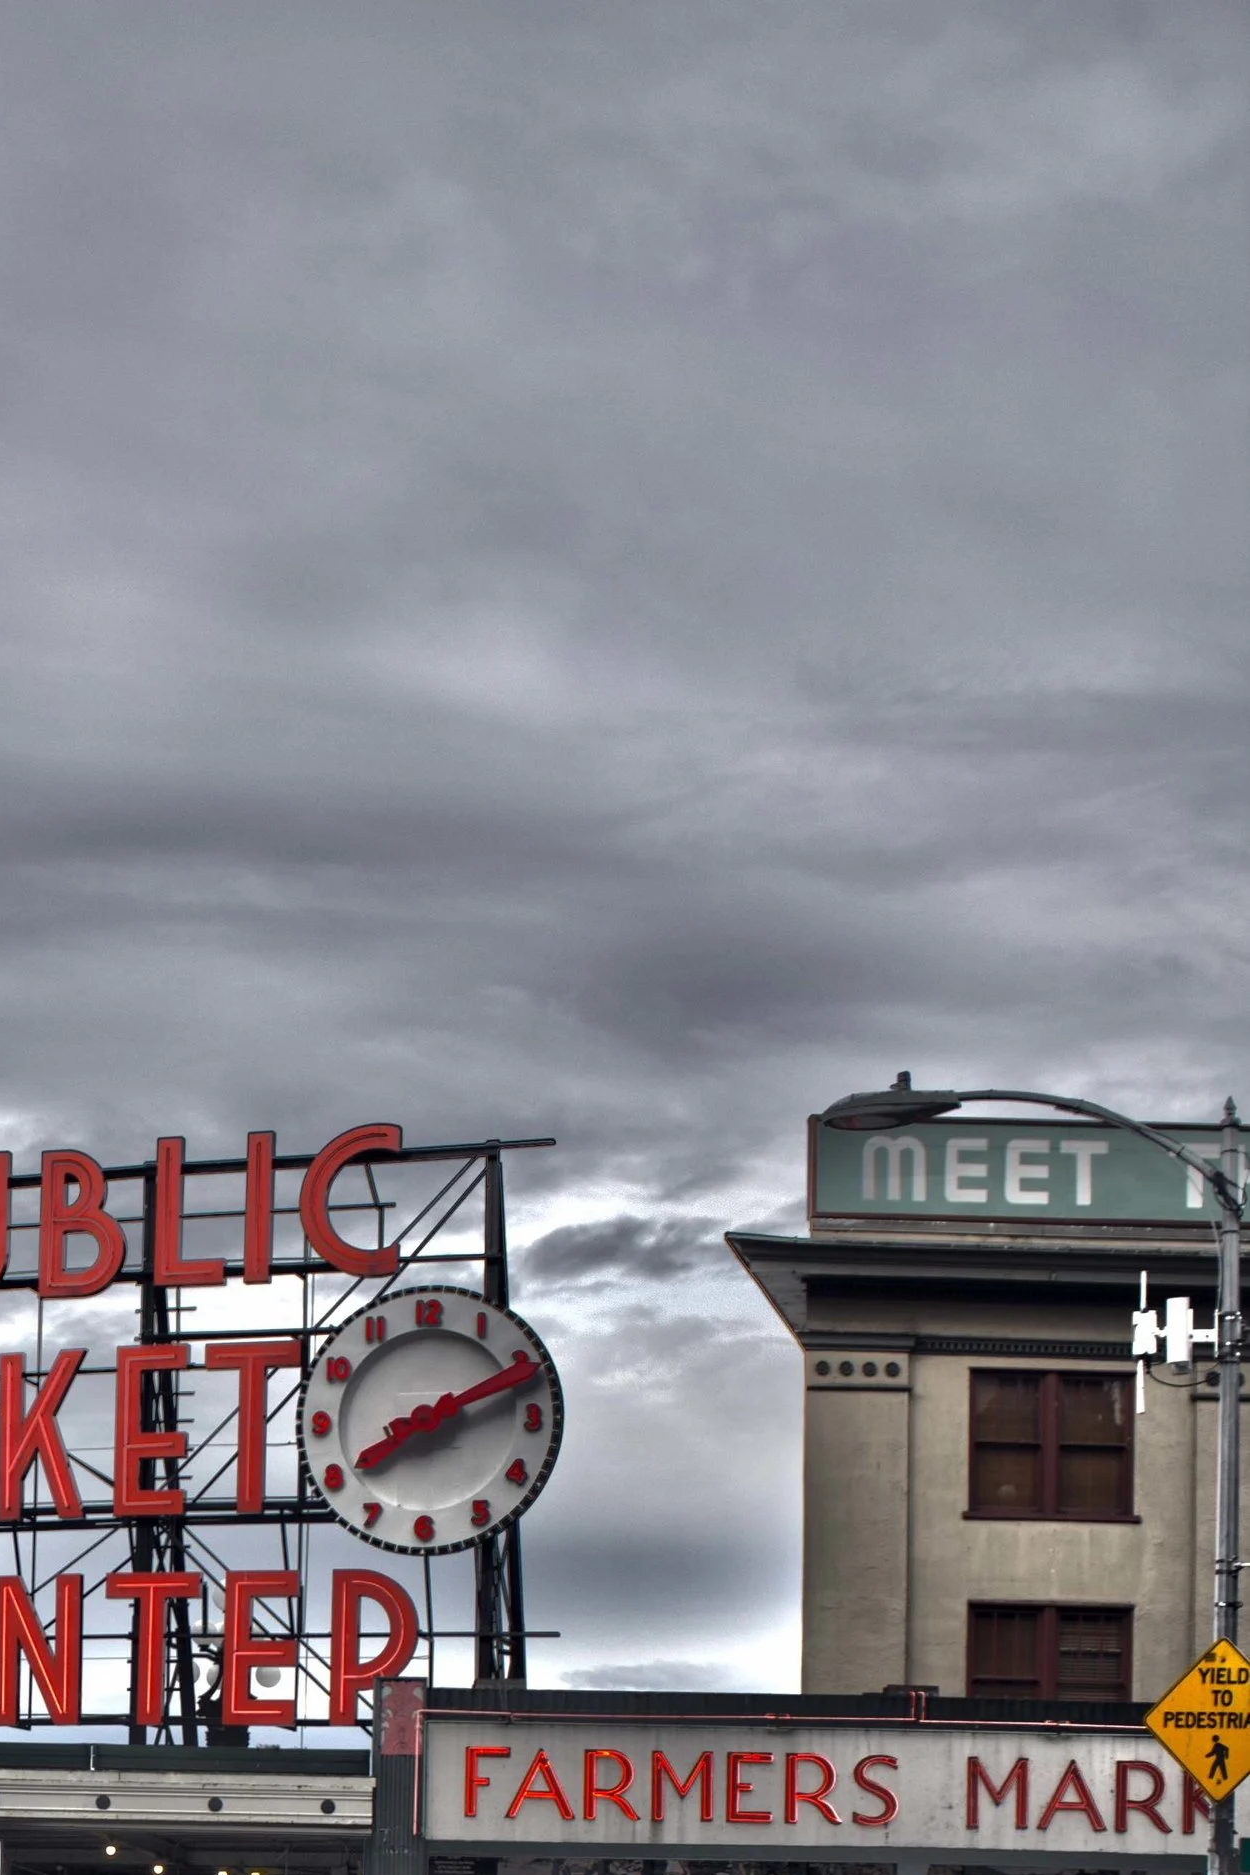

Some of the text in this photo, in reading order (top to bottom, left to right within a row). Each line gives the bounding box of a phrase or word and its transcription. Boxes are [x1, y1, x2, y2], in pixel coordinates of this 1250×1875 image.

[862, 1135, 1109, 1206] MEET
[415, 1299, 443, 1328] 12
[476, 1311, 487, 1339] 1
[365, 1315, 387, 1344] 11
[326, 1355, 351, 1383] 10
[311, 1410, 332, 1437] 9
[523, 1402, 543, 1432] 3
[324, 1463, 345, 1490] 8
[505, 1457, 528, 1486] 4
[362, 1501, 382, 1528] 7
[470, 1499, 491, 1526] 5
[413, 1514, 436, 1542] 6
[1198, 1667, 1249, 1685] YIELD
[1212, 1689, 1233, 1707] TO
[462, 1744, 900, 1828] FARMERS
